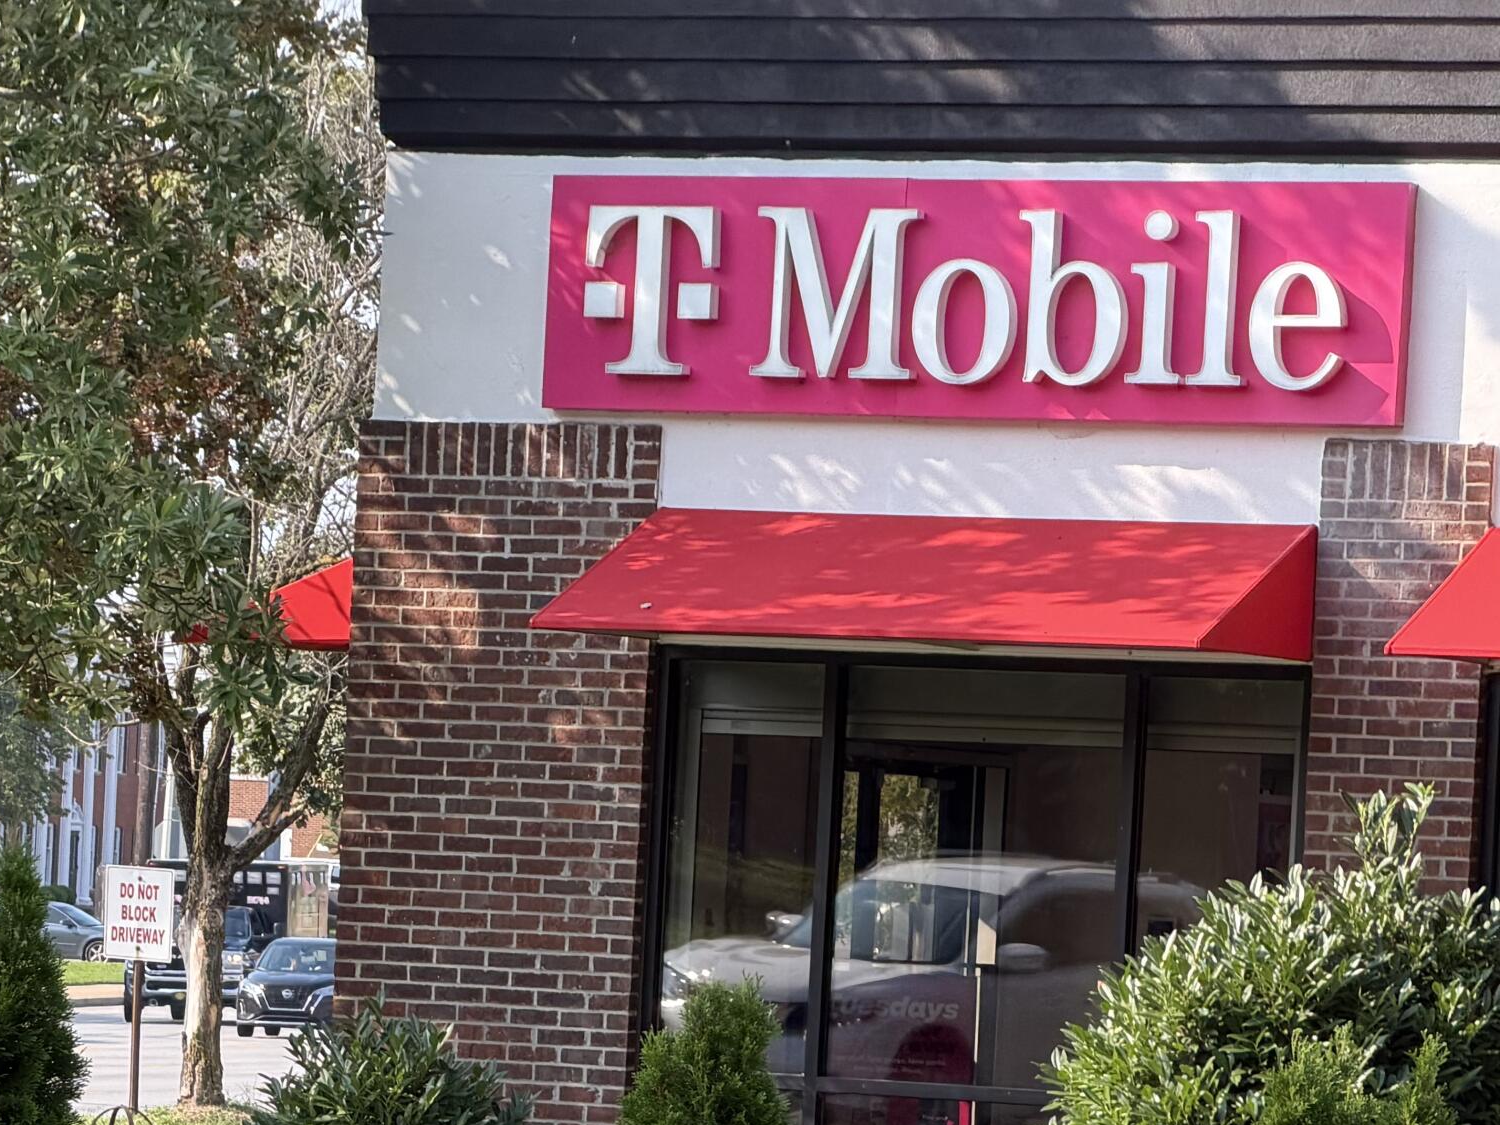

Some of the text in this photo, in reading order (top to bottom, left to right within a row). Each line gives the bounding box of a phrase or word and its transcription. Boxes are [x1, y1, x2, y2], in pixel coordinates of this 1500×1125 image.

[748, 205, 1348, 392] Mobile
[119, 882, 160, 900] DO NOT
[121, 904, 157, 923] BLOCK
[111, 926, 166, 945] DRIVEWAY
